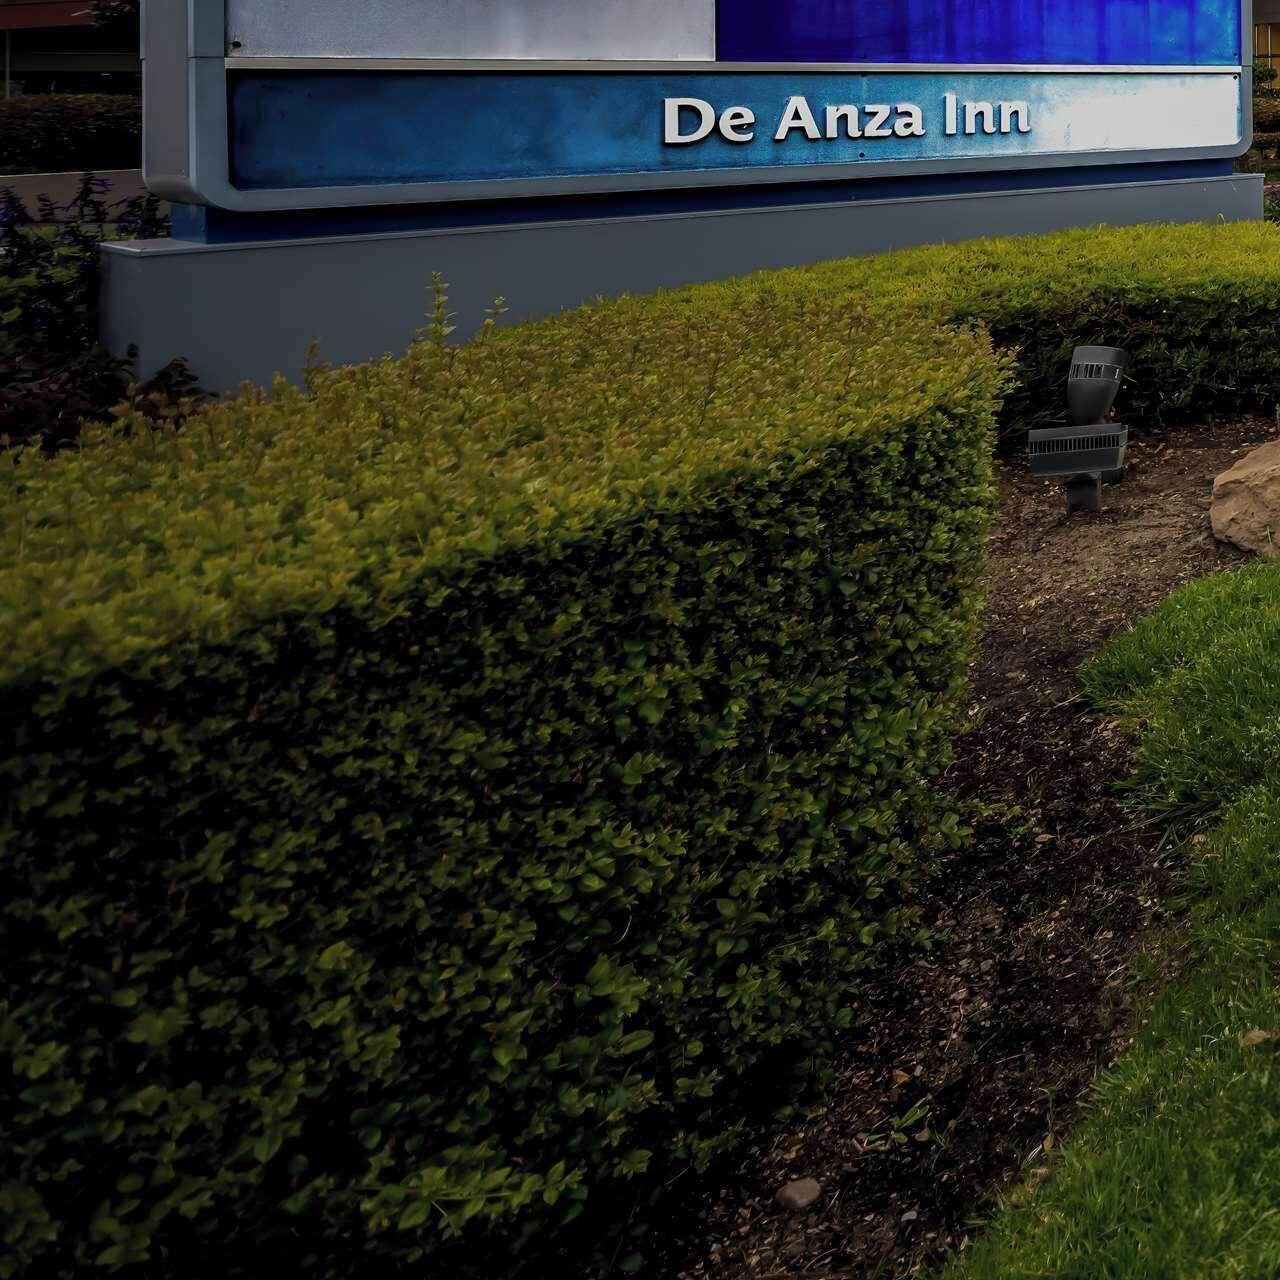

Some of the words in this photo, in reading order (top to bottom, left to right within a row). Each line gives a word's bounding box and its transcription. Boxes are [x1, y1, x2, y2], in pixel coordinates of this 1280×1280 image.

[664, 97, 756, 144] De
[774, 95, 926, 140] Anza
[944, 93, 1031, 134] Inn
